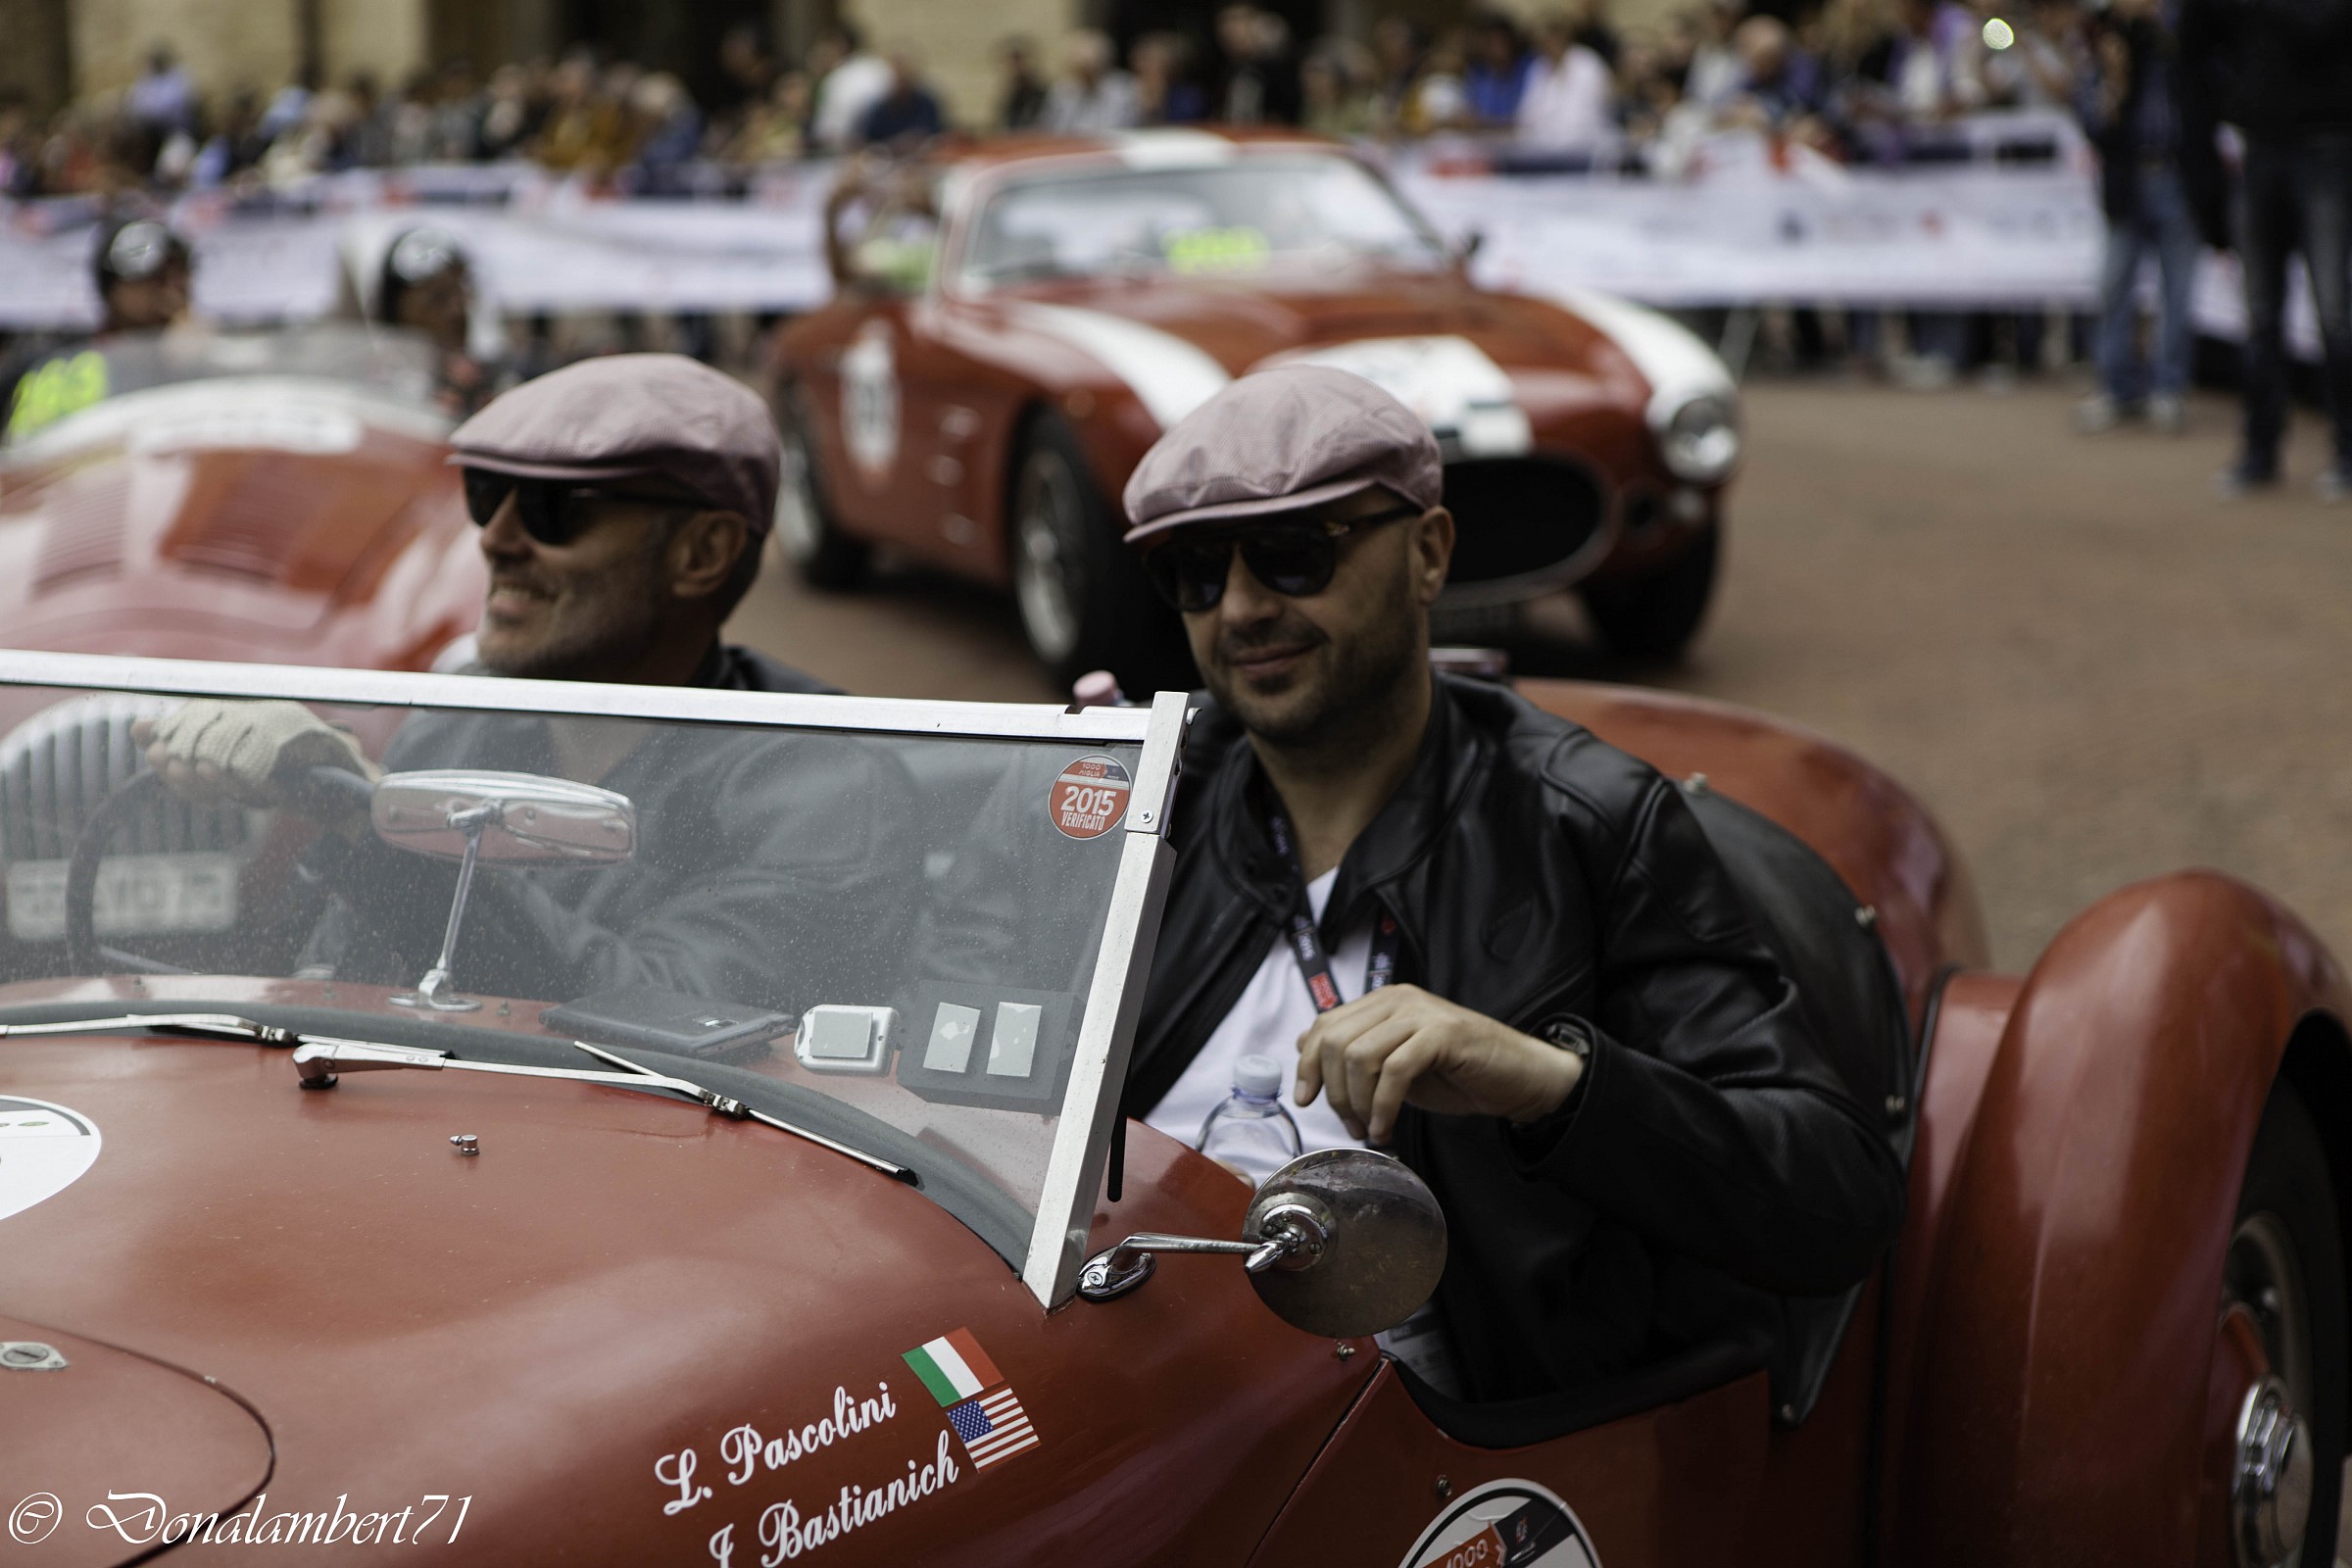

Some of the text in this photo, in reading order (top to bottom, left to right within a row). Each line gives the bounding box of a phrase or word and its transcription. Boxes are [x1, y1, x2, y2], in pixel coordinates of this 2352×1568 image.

[1060, 785, 1117, 816] 2015
[1060, 810, 1105, 831] VERIFICATO
[654, 1381, 897, 1516] L. Pascolini
[758, 1429, 959, 1568] Bastianich
